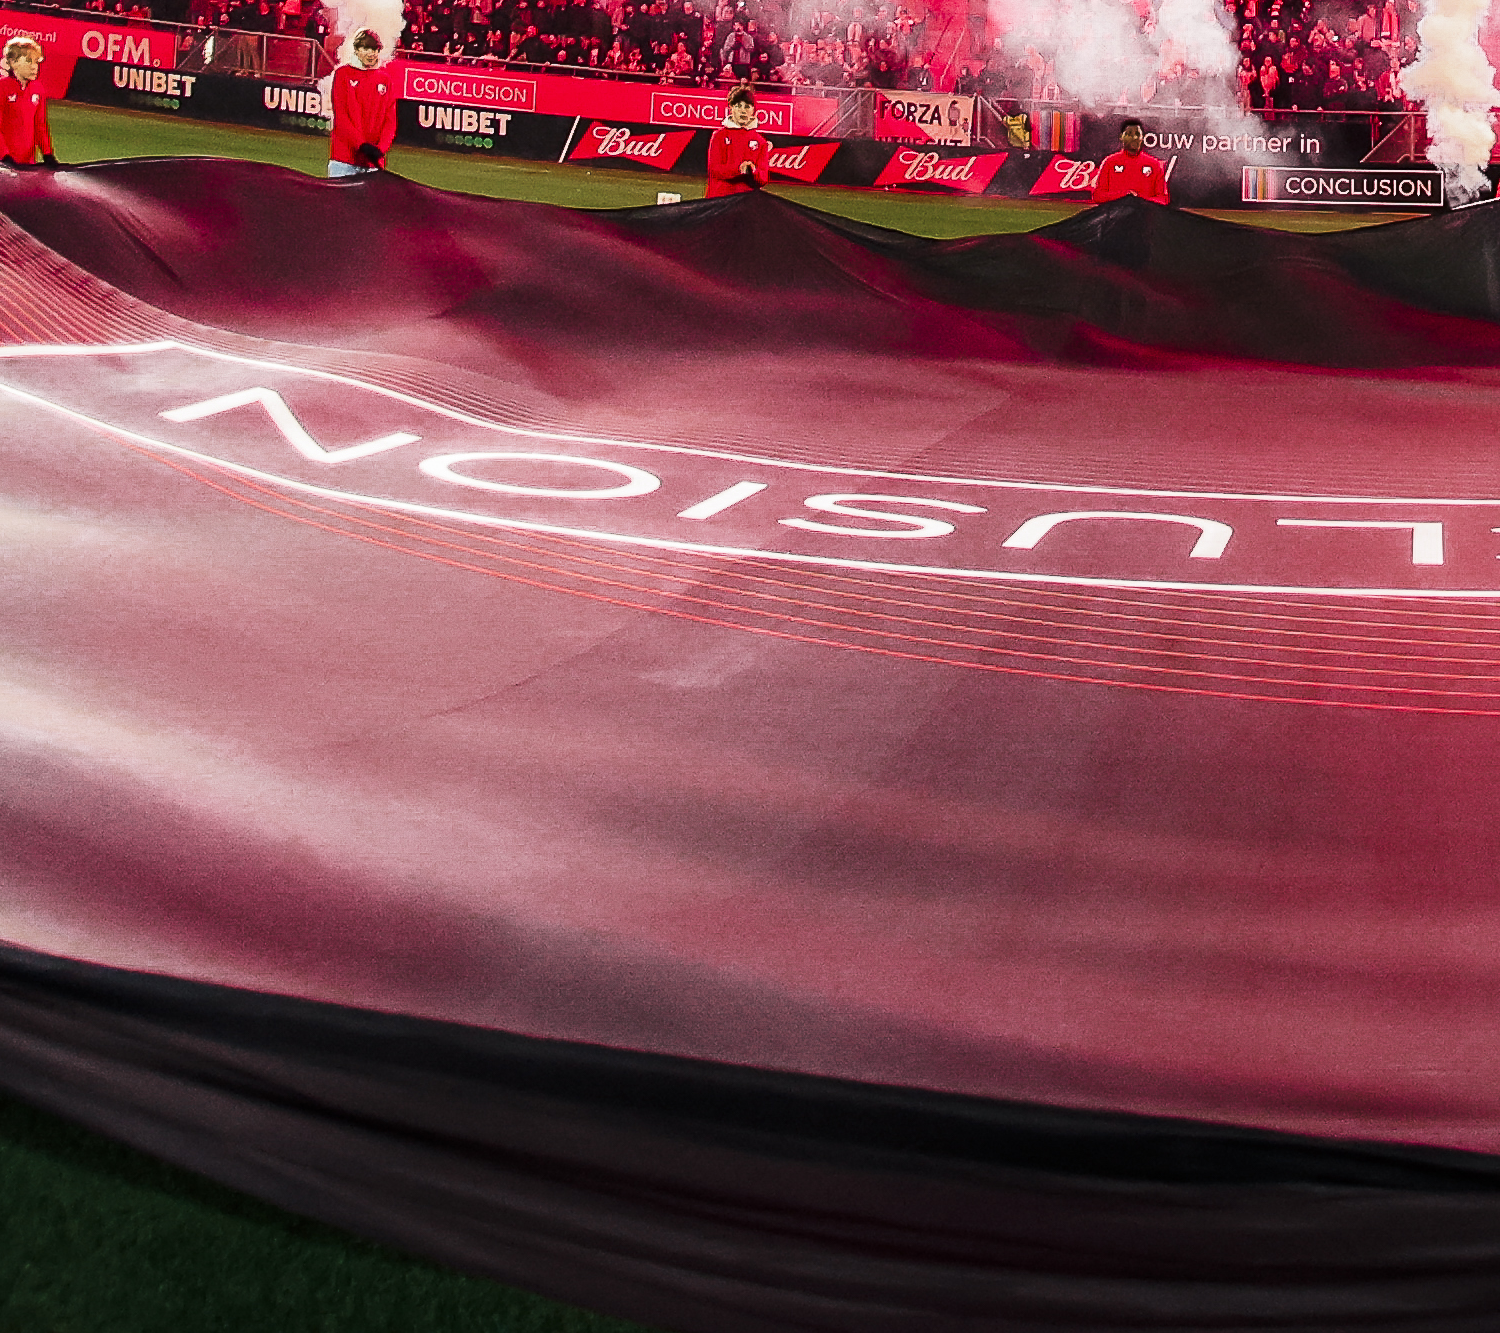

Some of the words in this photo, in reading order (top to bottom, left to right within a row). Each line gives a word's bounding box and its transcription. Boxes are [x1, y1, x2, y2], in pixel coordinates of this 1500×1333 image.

[81, 30, 161, 68] OFM.
[113, 65, 197, 98] UNIBET
[413, 77, 528, 103] CONCLUSION
[264, 85, 322, 115] UNIB
[660, 101, 784, 127] CONCLON
[879, 99, 943, 127] FORZA
[418, 104, 512, 136] UNIBET
[592, 126, 667, 158] Bud
[1143, 132, 1194, 150] ouw
[1202, 134, 1293, 154] partner
[1300, 134, 1320, 154] in
[898, 150, 979, 182] Bud
[1285, 176, 1433, 197] CONCLUSION
